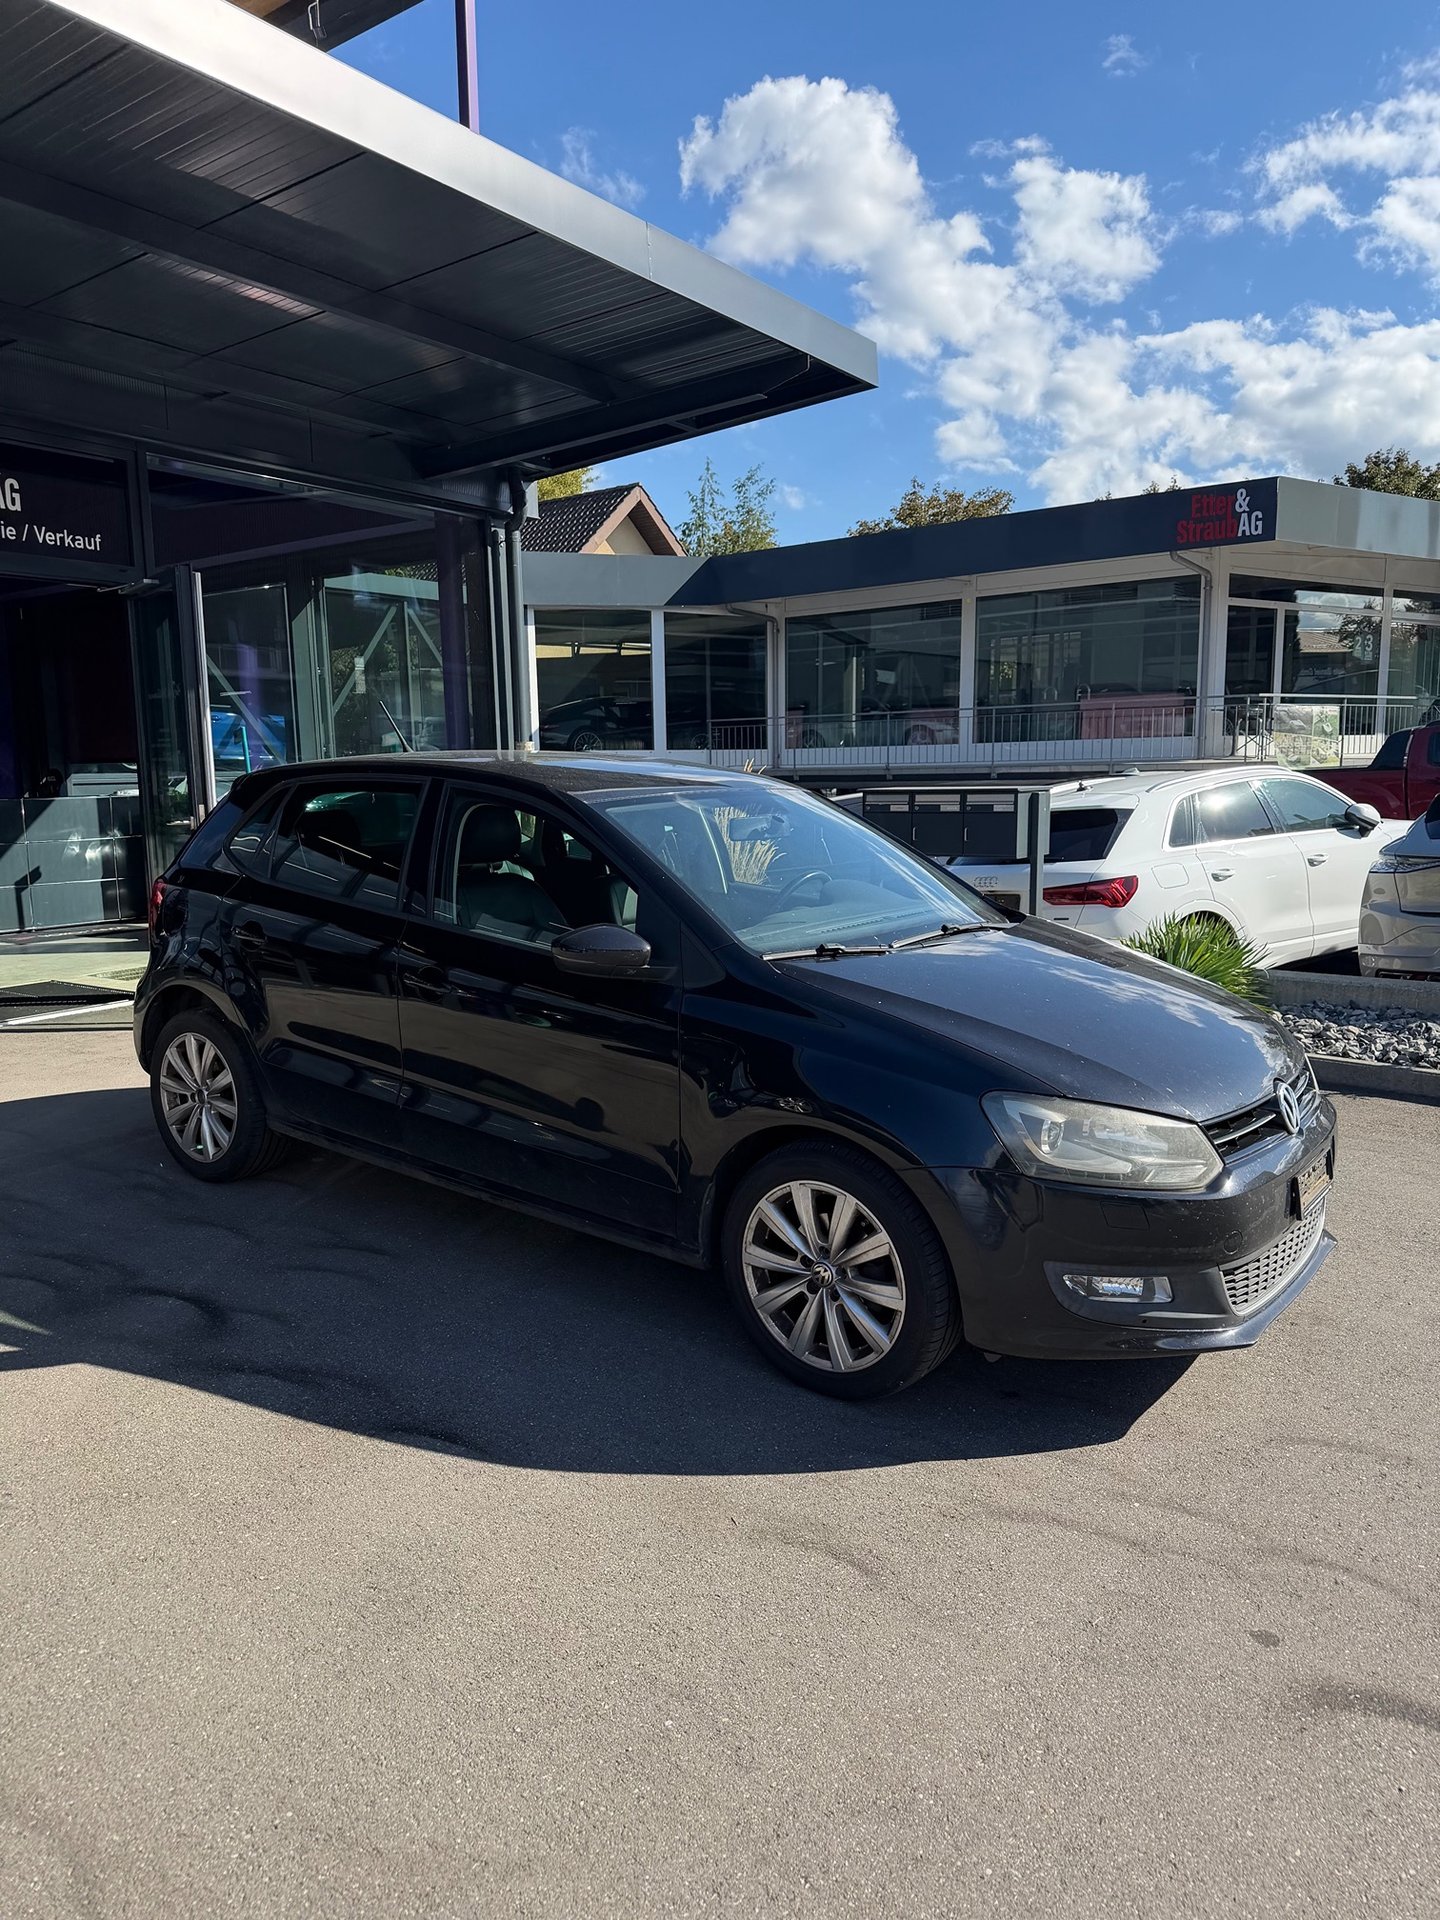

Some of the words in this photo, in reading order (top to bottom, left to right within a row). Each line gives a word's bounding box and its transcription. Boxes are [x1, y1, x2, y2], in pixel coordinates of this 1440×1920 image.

[1191, 495, 1236, 518] Etter
[1235, 488, 1250, 512] &
[22, 523, 28, 541] /
[33, 525, 101, 551] Verkauf
[1177, 519, 1238, 544] Straub
[1238, 511, 1263, 537] AG
